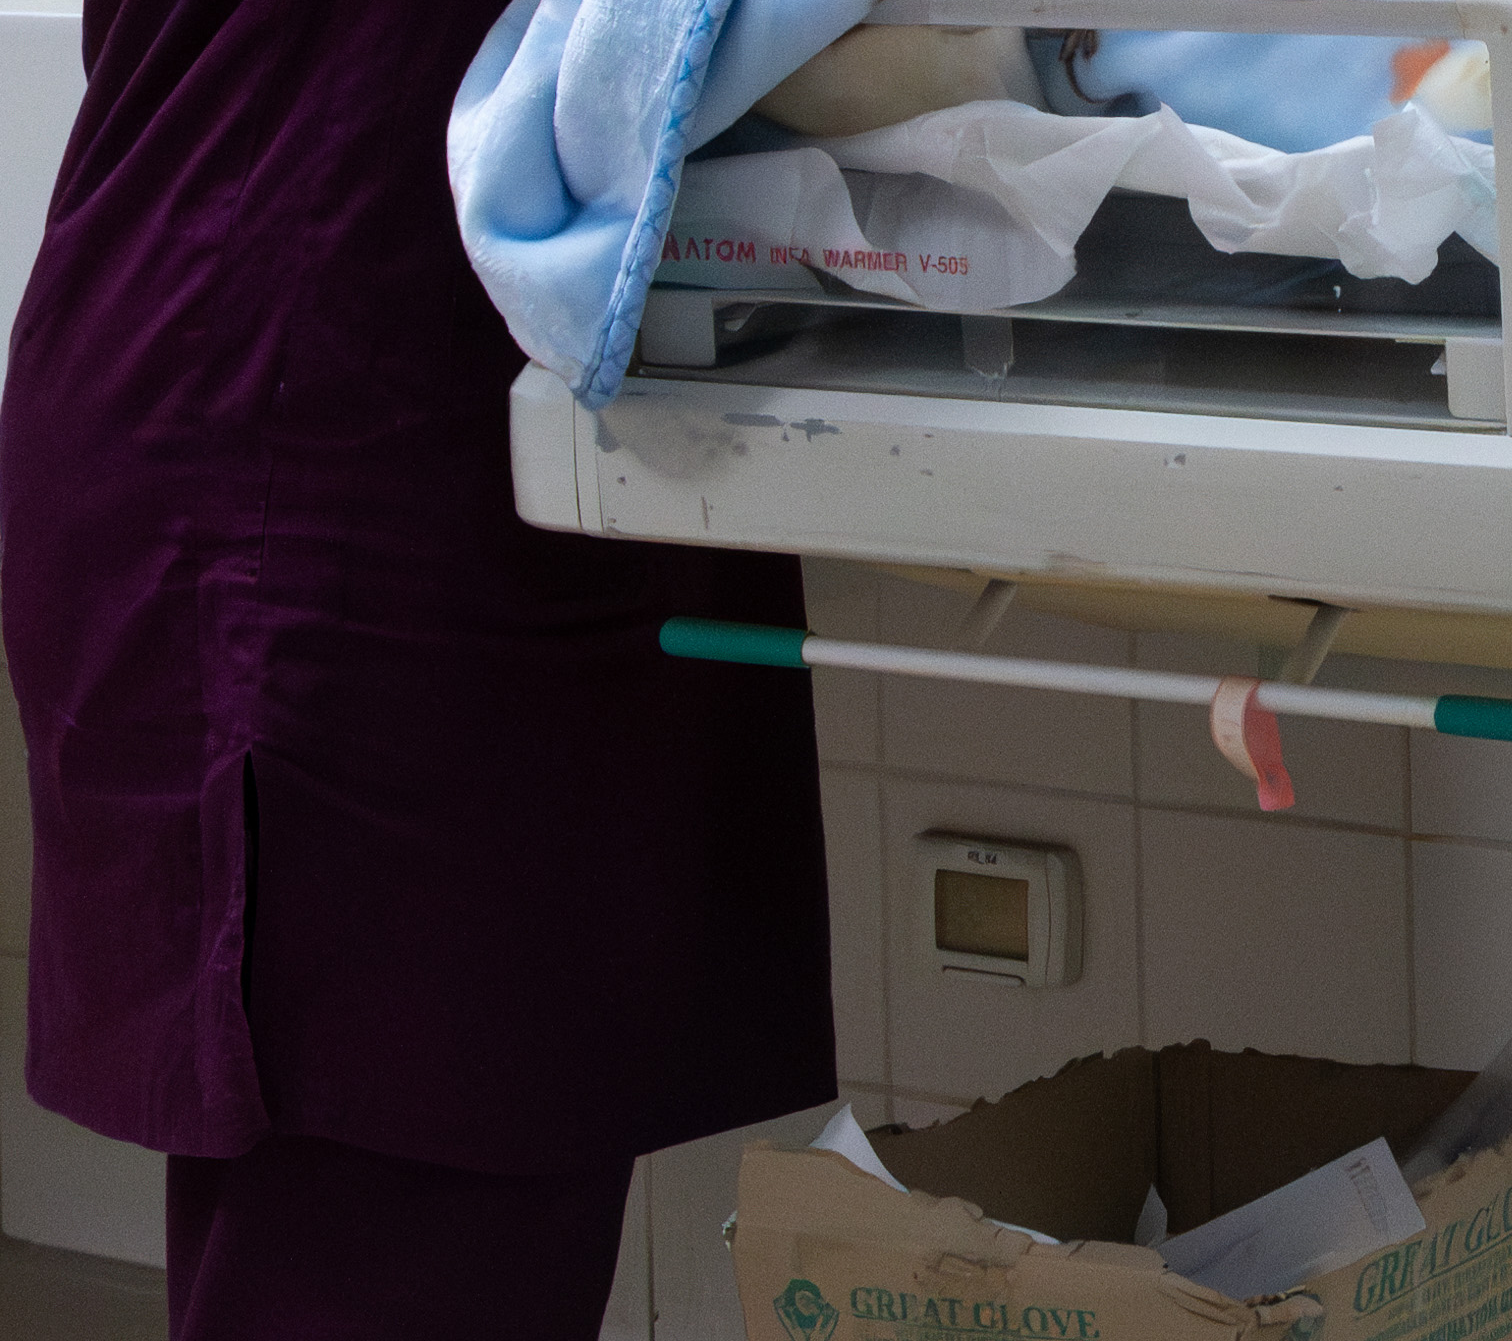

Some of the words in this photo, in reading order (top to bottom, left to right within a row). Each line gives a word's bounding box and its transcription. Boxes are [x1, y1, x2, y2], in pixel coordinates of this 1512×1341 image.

[684, 239, 757, 264] ATOM
[823, 248, 908, 273] WARMER
[919, 253, 970, 277] V-505
[1353, 1220, 1465, 1313] GREAT
[849, 1285, 962, 1327] GREAT
[972, 1299, 1101, 1340] GLOVE
